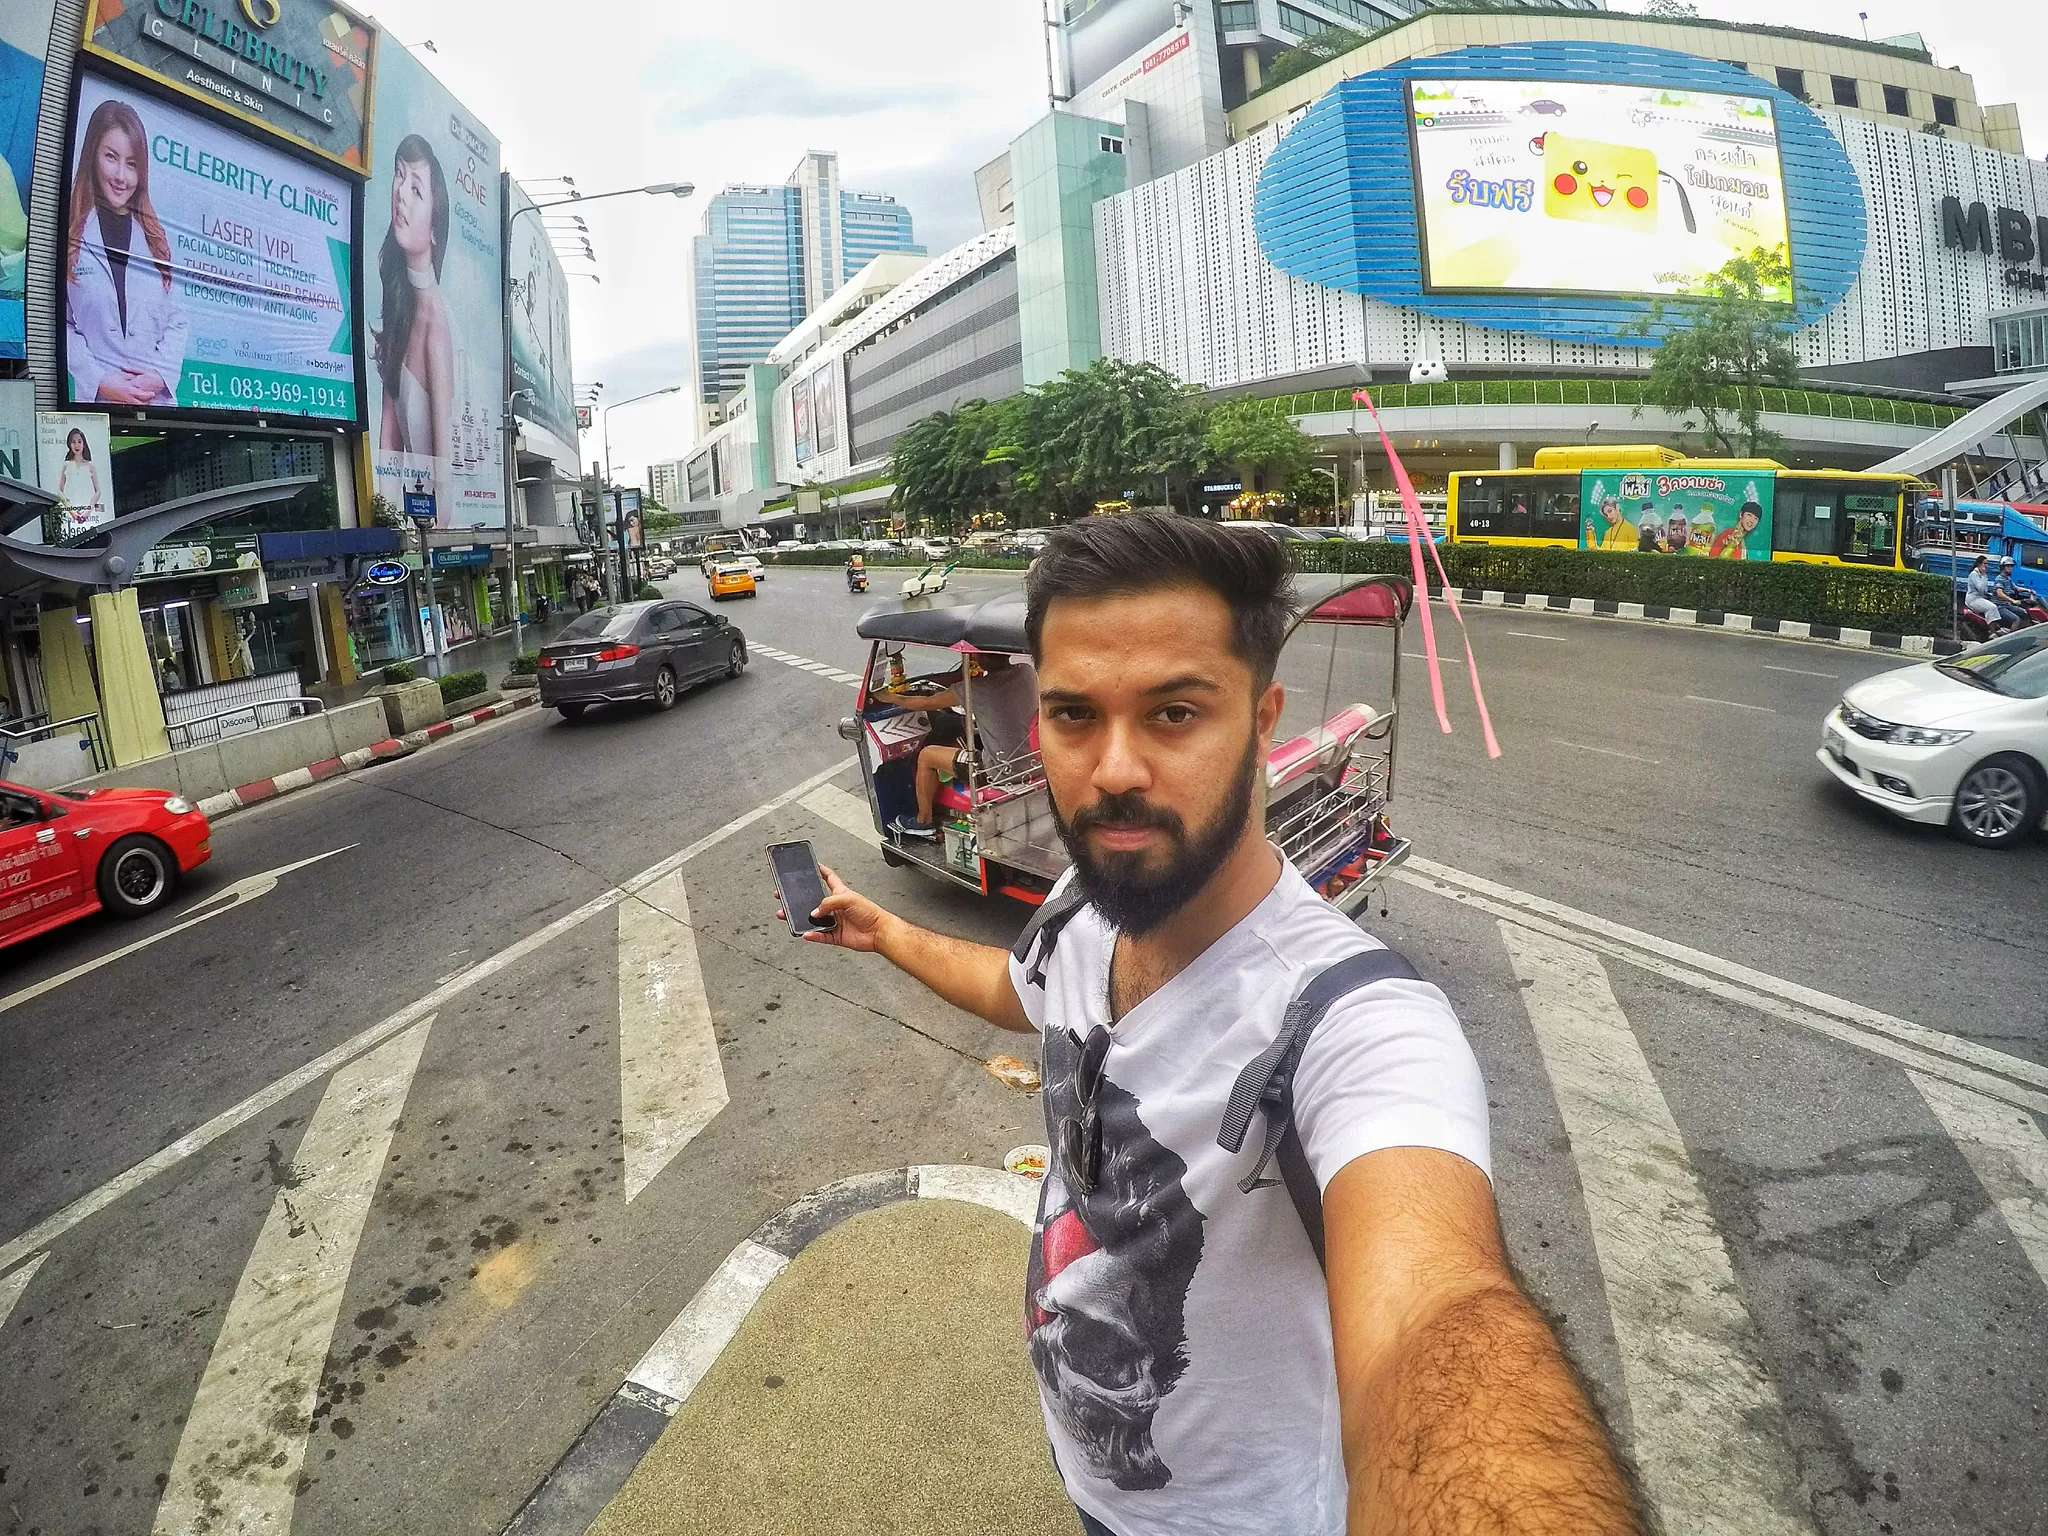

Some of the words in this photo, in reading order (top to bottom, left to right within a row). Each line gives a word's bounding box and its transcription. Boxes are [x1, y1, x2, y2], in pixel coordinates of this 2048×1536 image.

[157, 0, 328, 98] CELEBRITY
[186, 68, 232, 98] Aesthetic
[234, 90, 241, 102] &
[243, 94, 264, 113] Skin
[152, 135, 273, 200] CELEBRITY
[279, 184, 339, 226] CLINIC
[455, 167, 487, 207] ACNE
[1446, 169, 1535, 212] รับฟรี
[1683, 163, 1769, 200] โปเกมอน
[201, 213, 253, 249] LASER
[265, 235, 299, 264] VIPL
[1941, 195, 2048, 268] MB
[177, 234, 214, 257] FACIAL
[217, 246, 254, 267] DESIGN
[264, 260, 317, 285] TREATMENT
[2004, 267, 2048, 293] CEN
[184, 282, 254, 309] LIPOSUCTION
[264, 301, 318, 323] ANTI-AGING
[188, 372, 224, 396] Tel.
[230, 377, 346, 408] 083-969-1914
